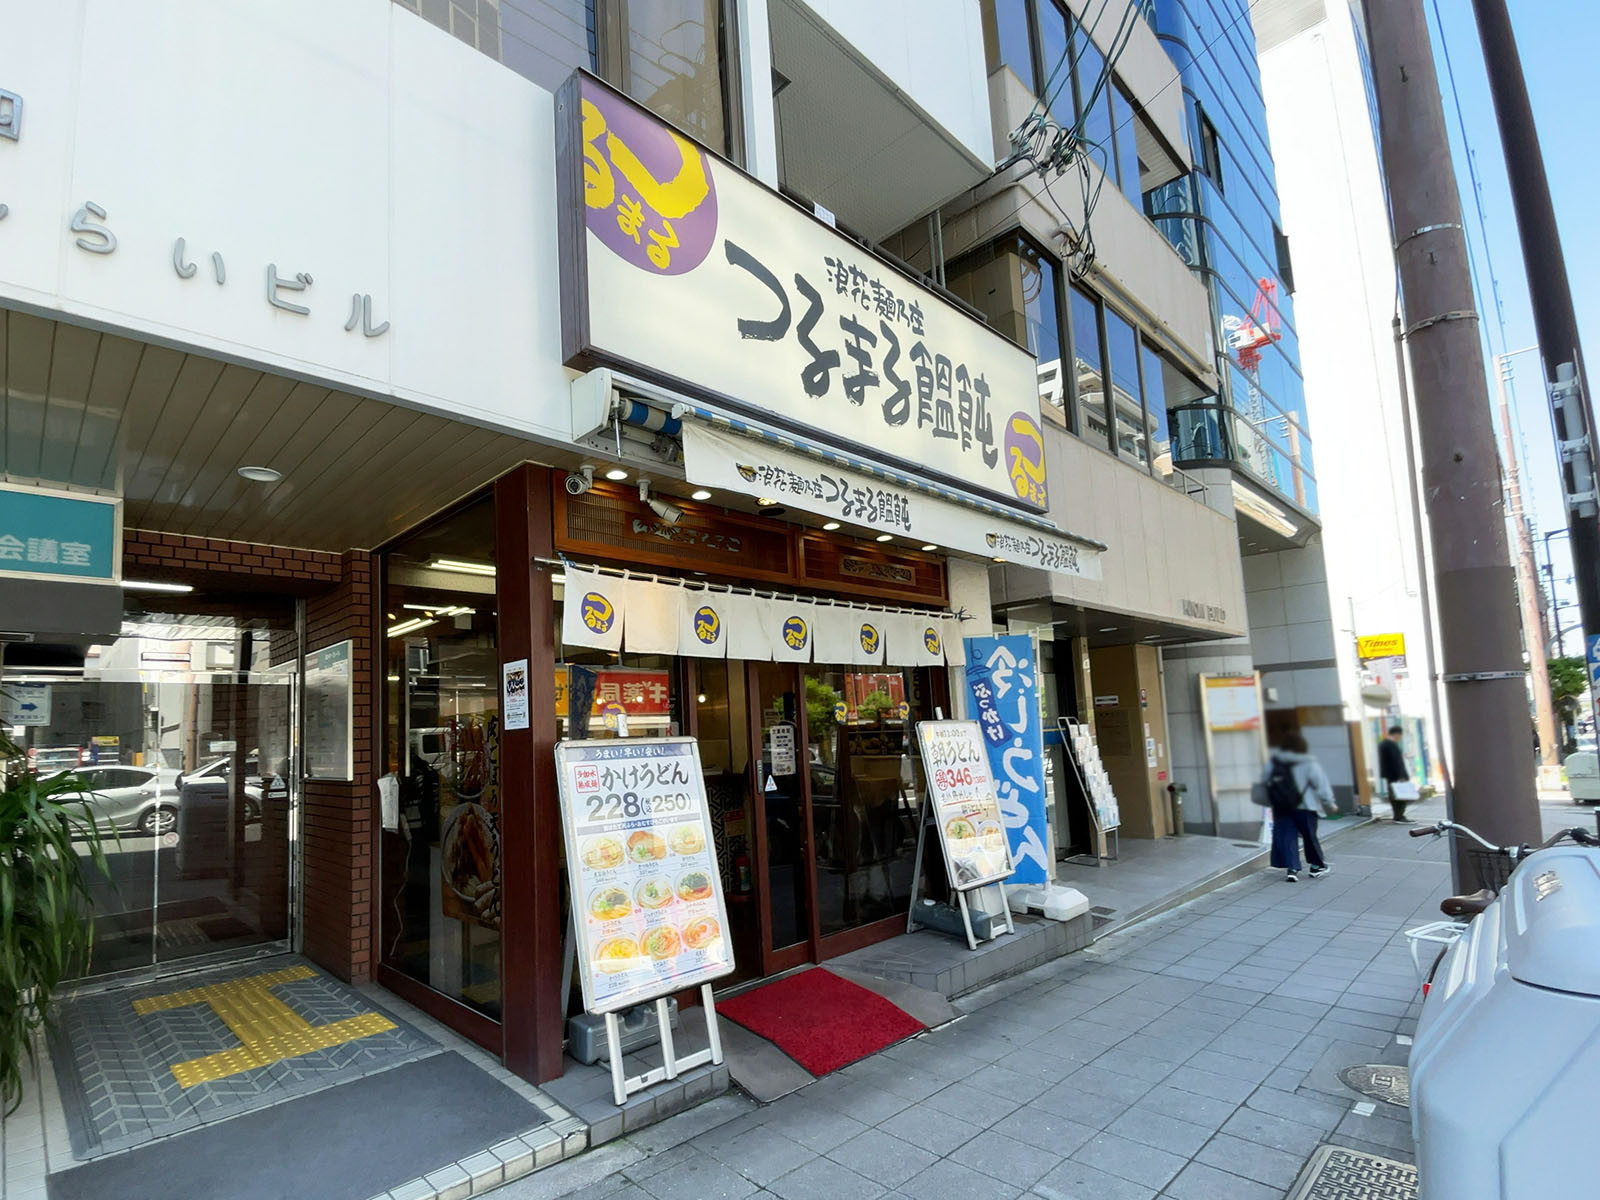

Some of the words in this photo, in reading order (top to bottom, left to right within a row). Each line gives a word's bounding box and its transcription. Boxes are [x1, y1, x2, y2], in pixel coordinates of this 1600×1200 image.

[0, 202, 390, 338] らいビル
[724, 239, 998, 470] つるまる饂飩
[0, 534, 91, 566] 会議室
[1363, 639, 1398, 648] Times
[931, 741, 980, 768] 朝うどん
[601, 761, 689, 792] かけうどん
[946, 767, 973, 788] 346
[586, 792, 641, 822] 228
